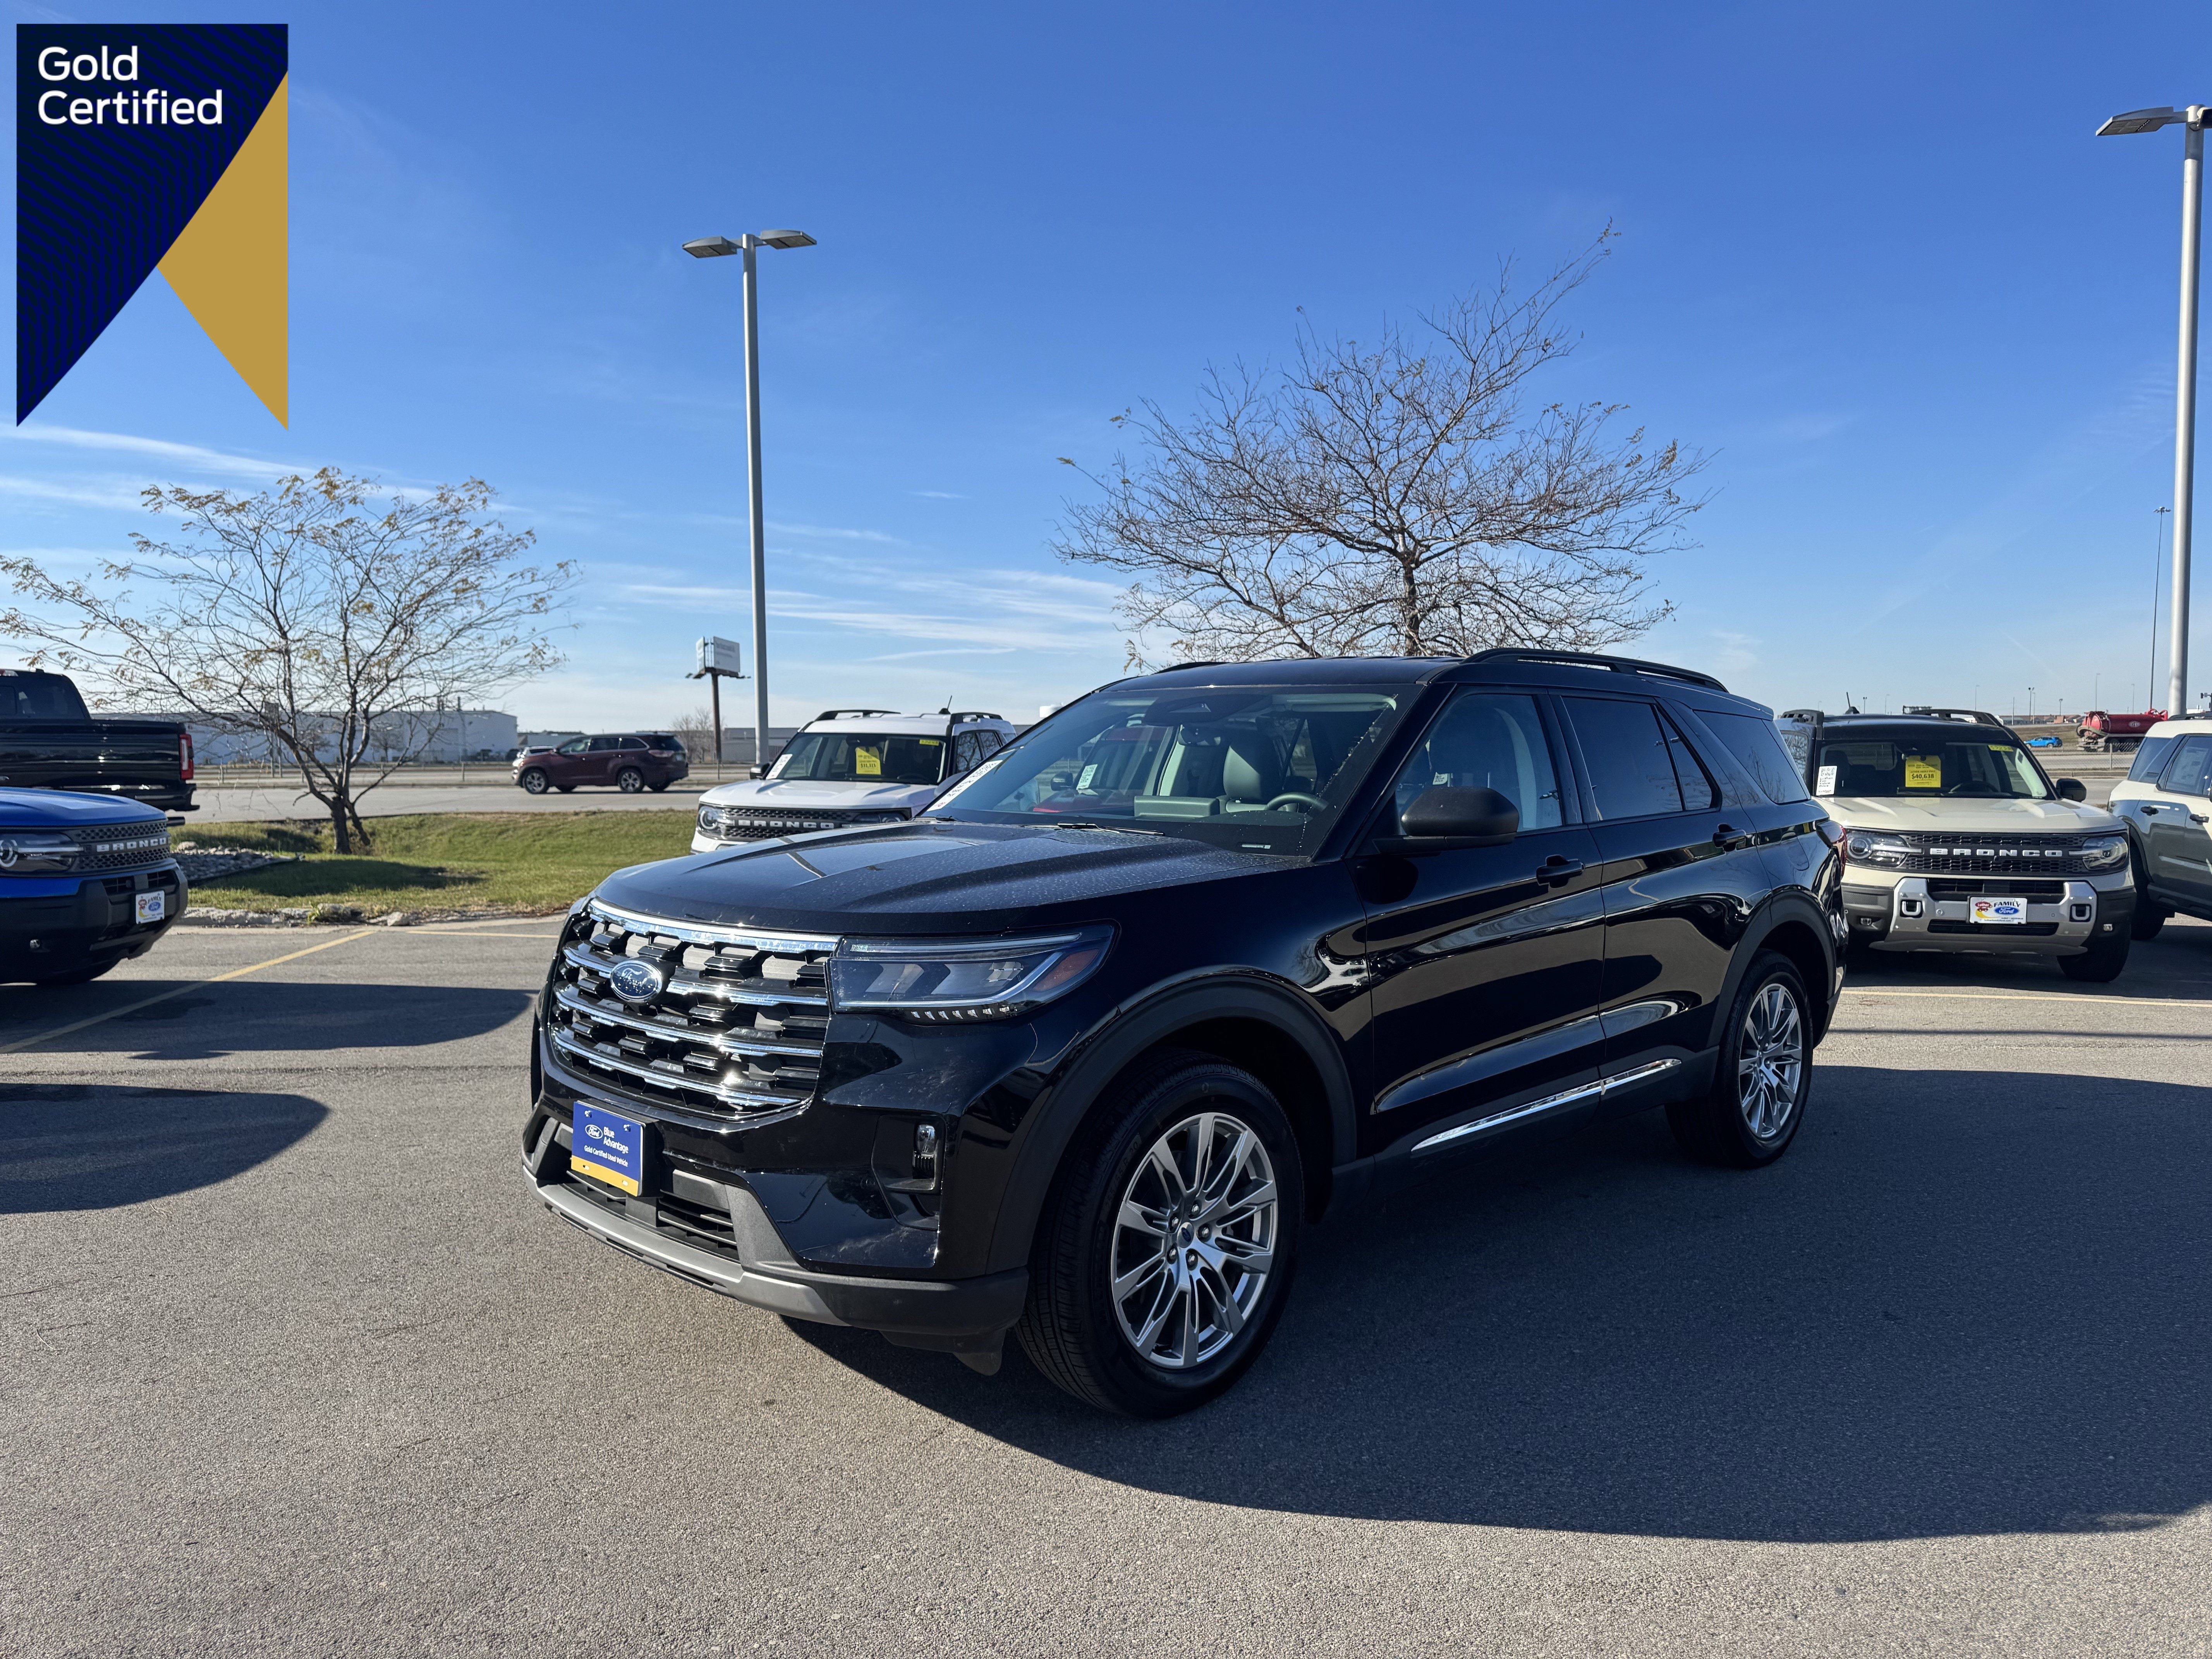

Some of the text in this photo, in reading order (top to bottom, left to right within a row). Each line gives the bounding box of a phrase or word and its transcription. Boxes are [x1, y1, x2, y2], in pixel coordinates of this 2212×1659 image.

[738, 819, 834, 829] BRONCO
[96, 837, 167, 852] BRONCO
[1930, 848, 2063, 857] BRONCO
[588, 1125, 600, 1137] Ford
[604, 1126, 615, 1139] Blue
[603, 1136, 629, 1154] Advantage
[584, 1145, 629, 1167] Gold Certified Used Vehicle
